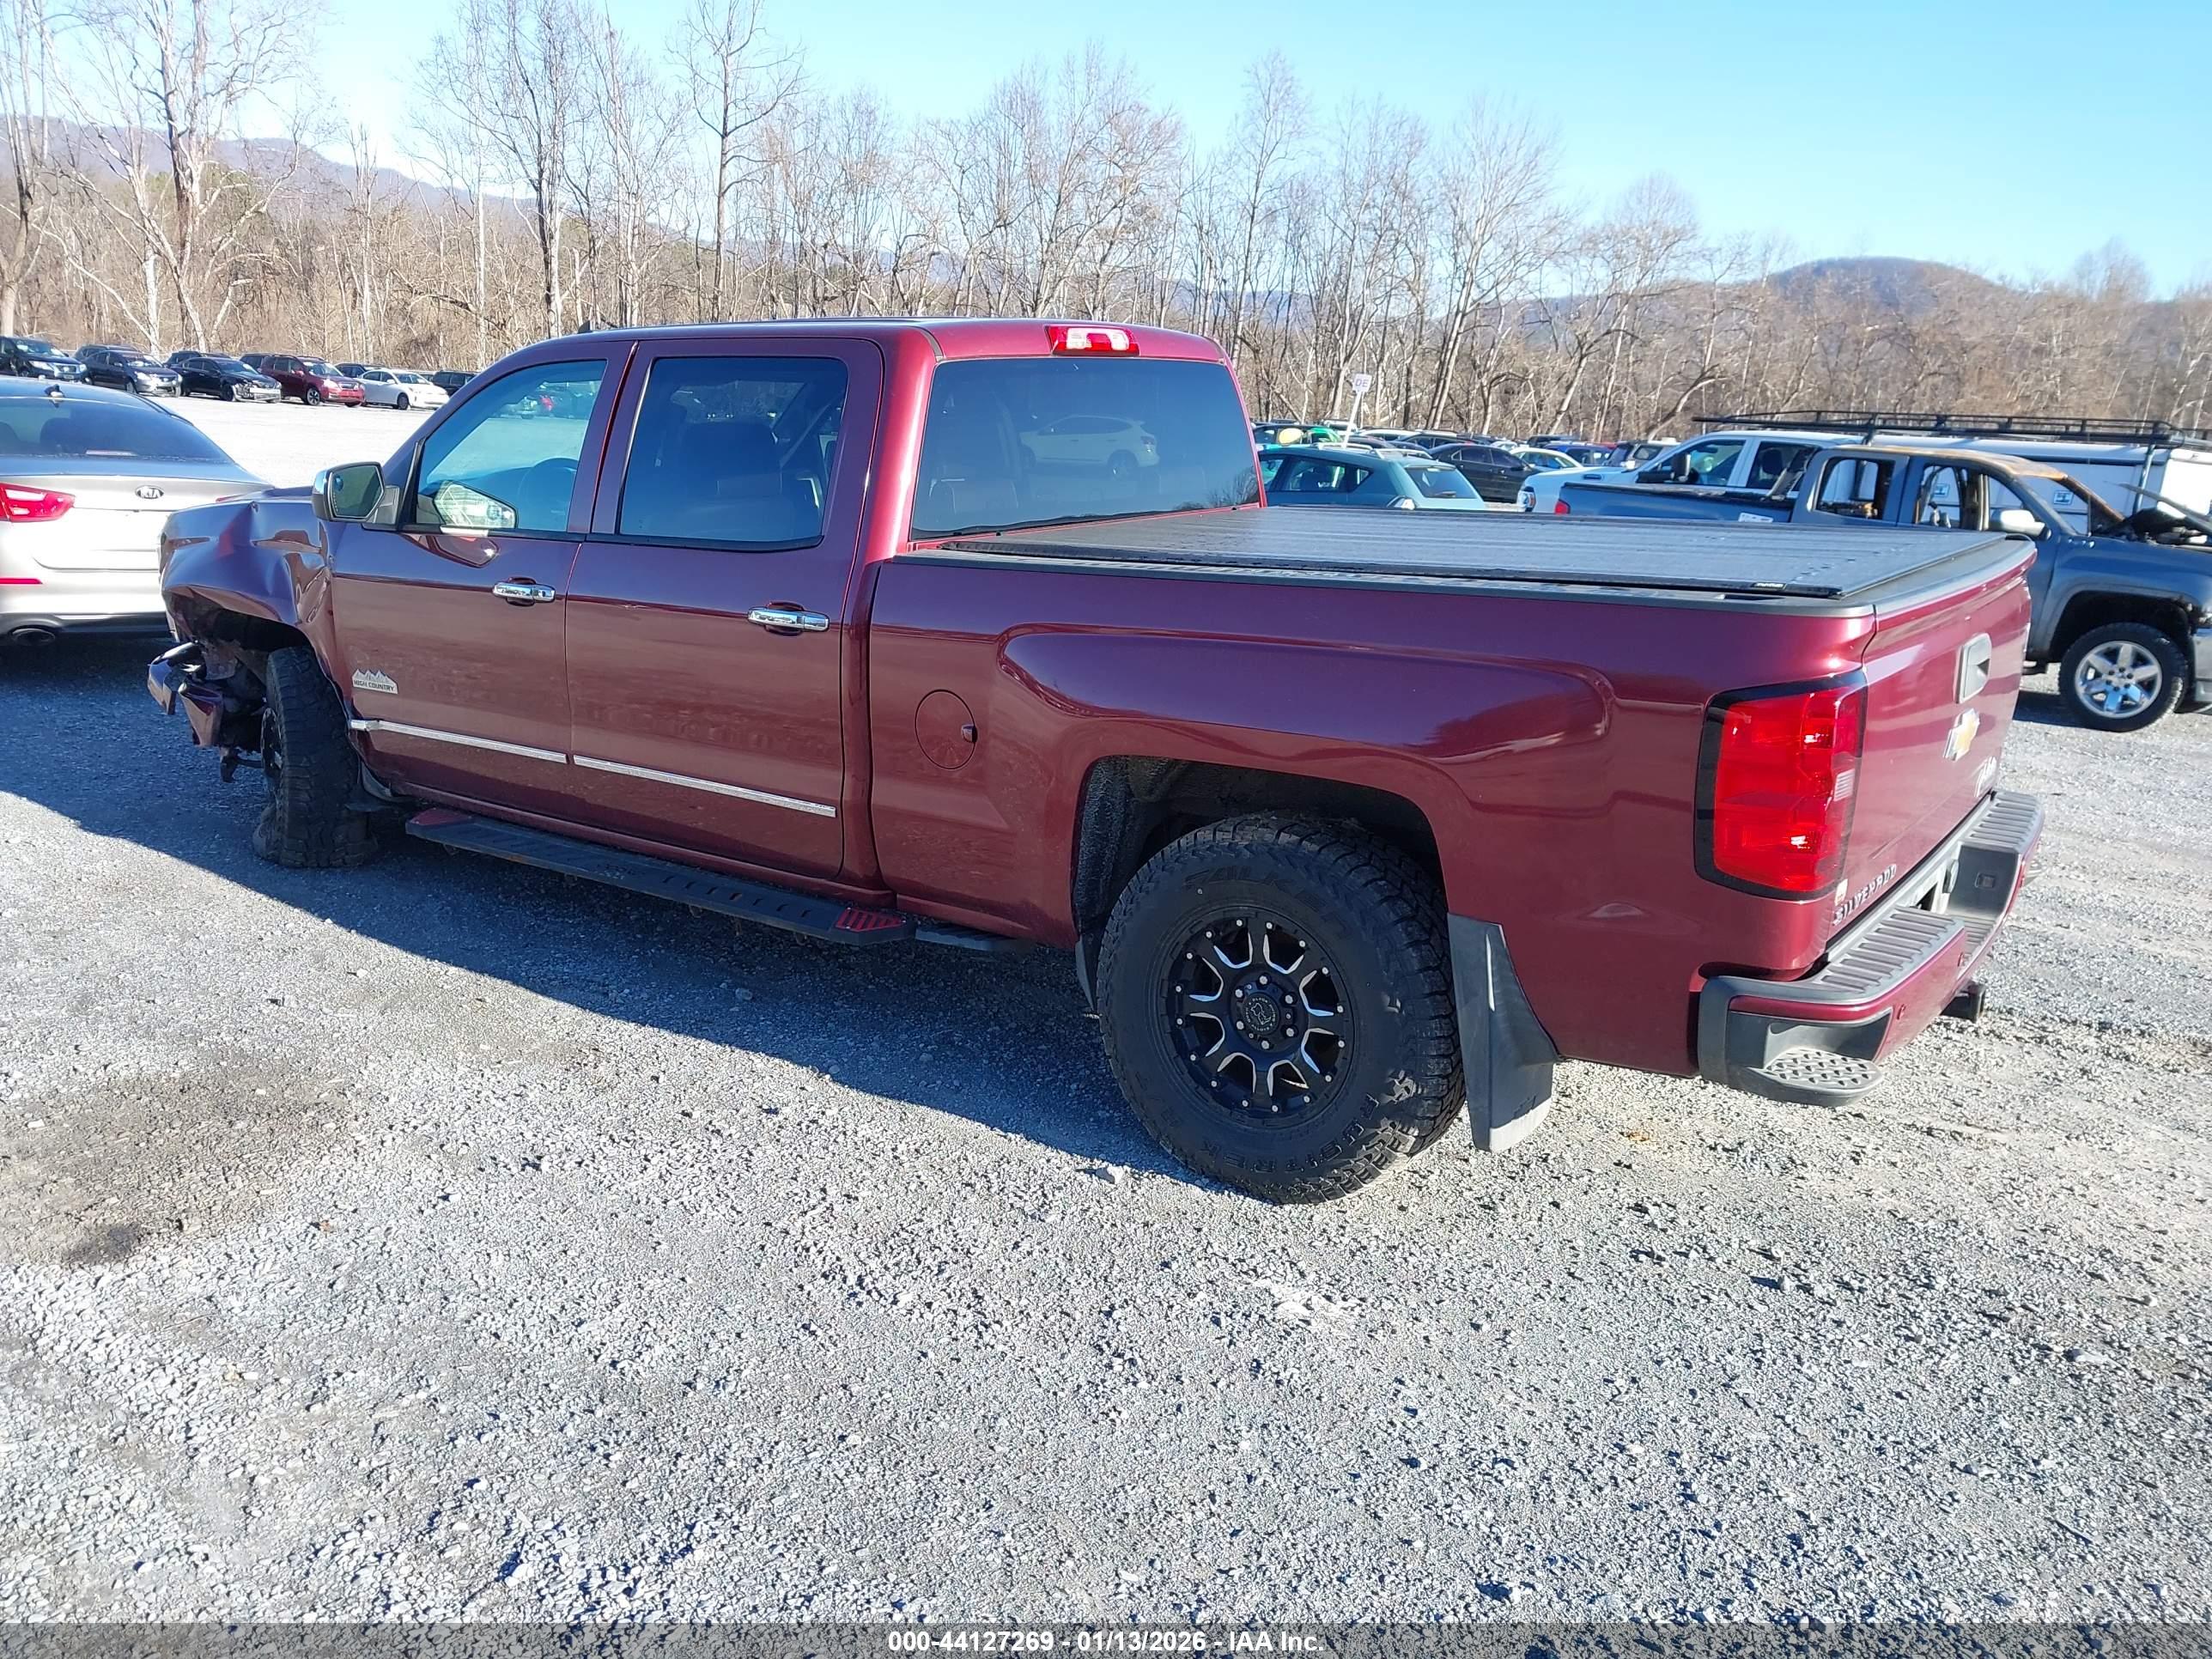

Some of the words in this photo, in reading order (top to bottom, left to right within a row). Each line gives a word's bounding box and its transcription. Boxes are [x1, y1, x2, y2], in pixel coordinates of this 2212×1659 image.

[139, 487, 161, 499] KIA
[353, 679, 368, 688] HIGH
[368, 681, 395, 691] COUNTRY
[1832, 863, 1897, 927] SILVERADO
